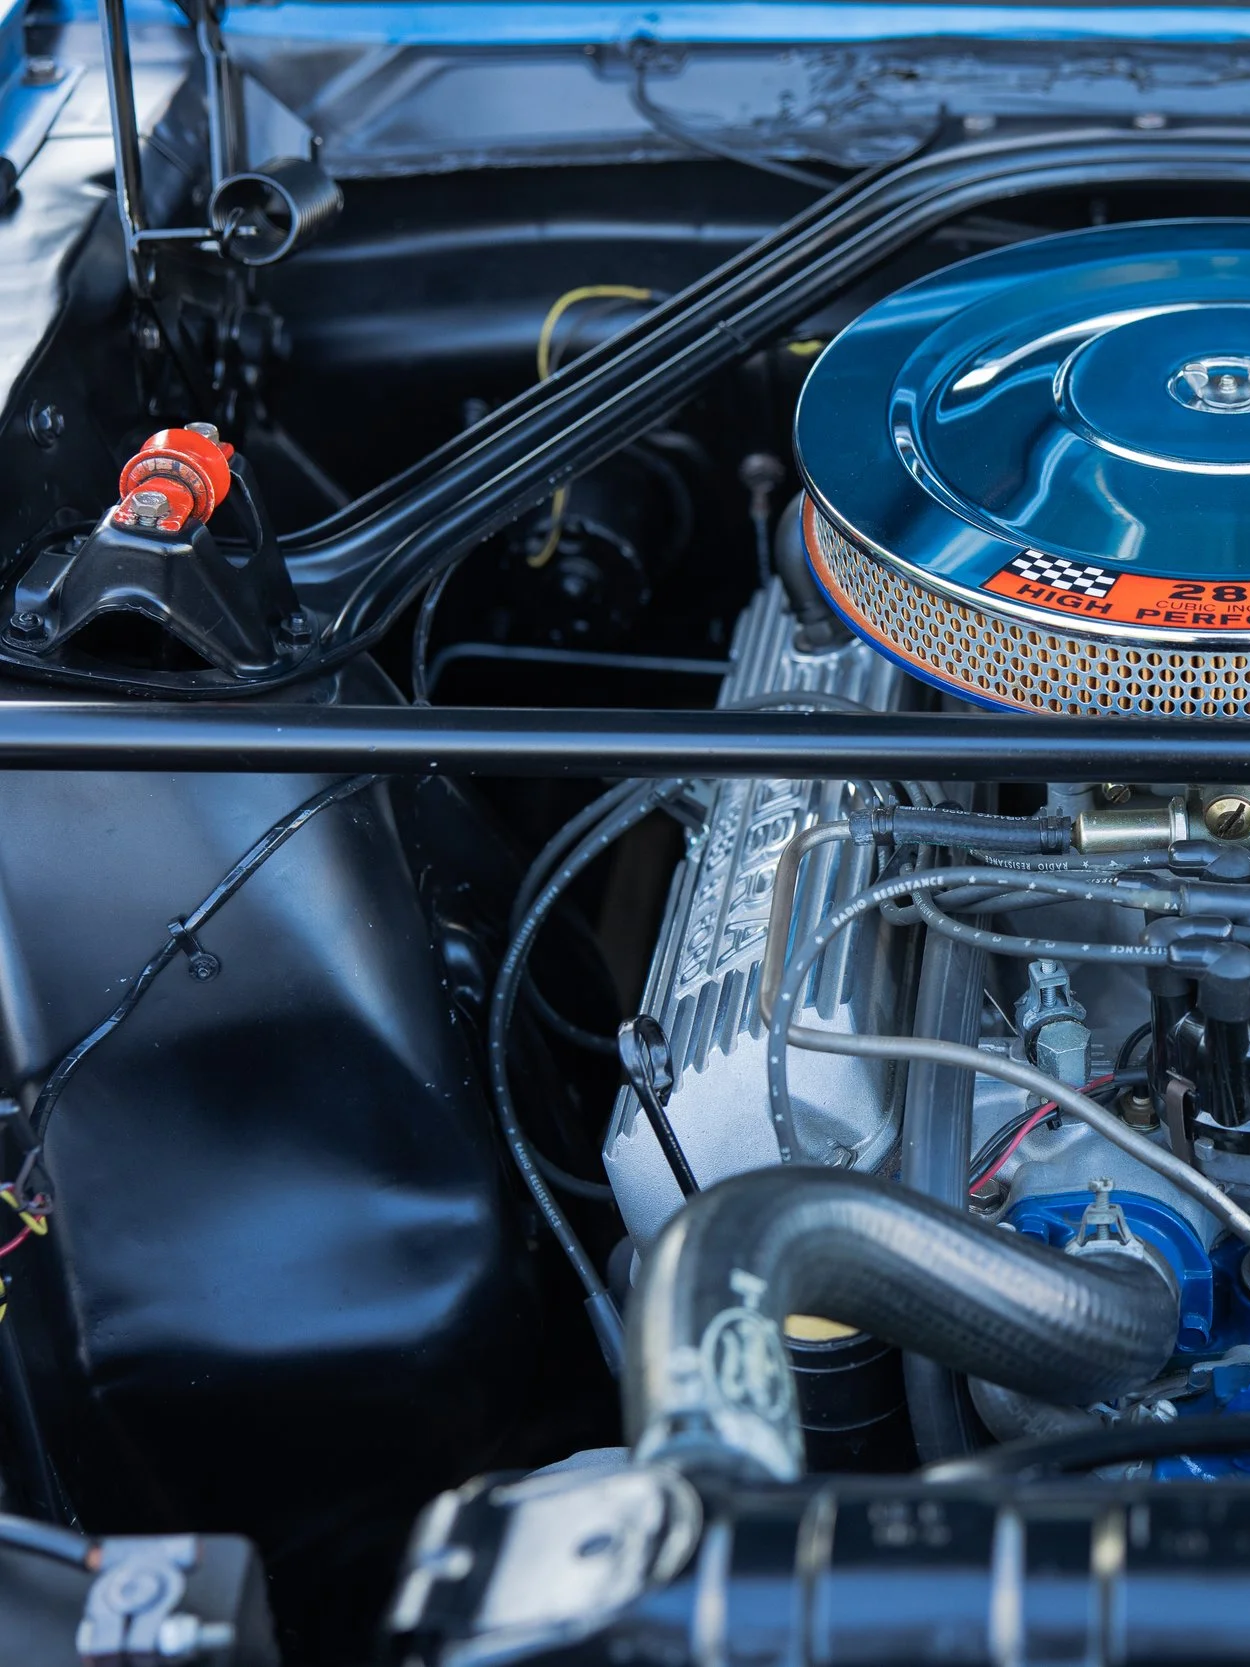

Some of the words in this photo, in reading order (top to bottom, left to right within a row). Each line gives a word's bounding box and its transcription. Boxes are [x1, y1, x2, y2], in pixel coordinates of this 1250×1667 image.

[1016, 583, 1113, 614] HIGH
[1155, 600, 1216, 612] CUBIC
[985, 855, 1031, 870] RESISTANCE
[1038, 861, 1068, 871] RADIO
[831, 898, 867, 928] RADIO
[872, 875, 944, 902] RESISTANCE
[1163, 902, 1182, 911] RA
[515, 1141, 532, 1170] RADIO
[529, 1173, 562, 1228] RESISTANCE
